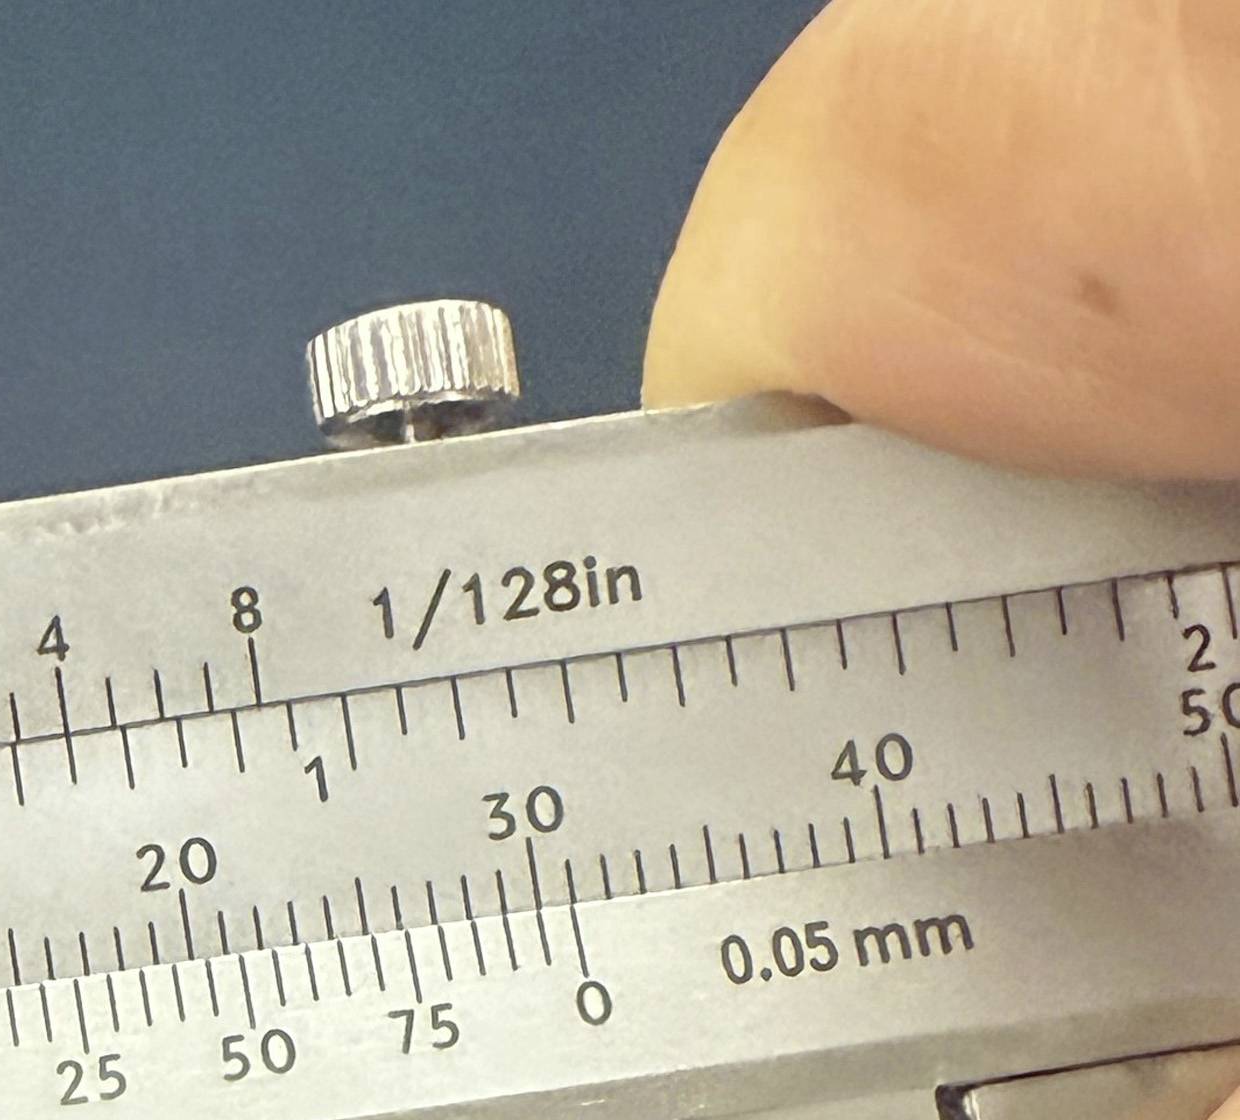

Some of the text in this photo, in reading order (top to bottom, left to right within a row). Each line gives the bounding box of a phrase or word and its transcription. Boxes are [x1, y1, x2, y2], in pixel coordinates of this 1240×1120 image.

[36, 614, 70, 662] 4
[230, 586, 263, 634] 8
[371, 555, 643, 651] 1/128in
[304, 623, 1217, 803] 1 2
[136, 837, 218, 893] 20
[482, 785, 564, 840] 30
[830, 732, 914, 786] 40
[720, 913, 975, 985] 0.05 mm
[56, 1053, 127, 1106] 25
[221, 1029, 297, 1082] 50
[388, 1003, 460, 1055] 75
[575, 980, 613, 1026] 0
